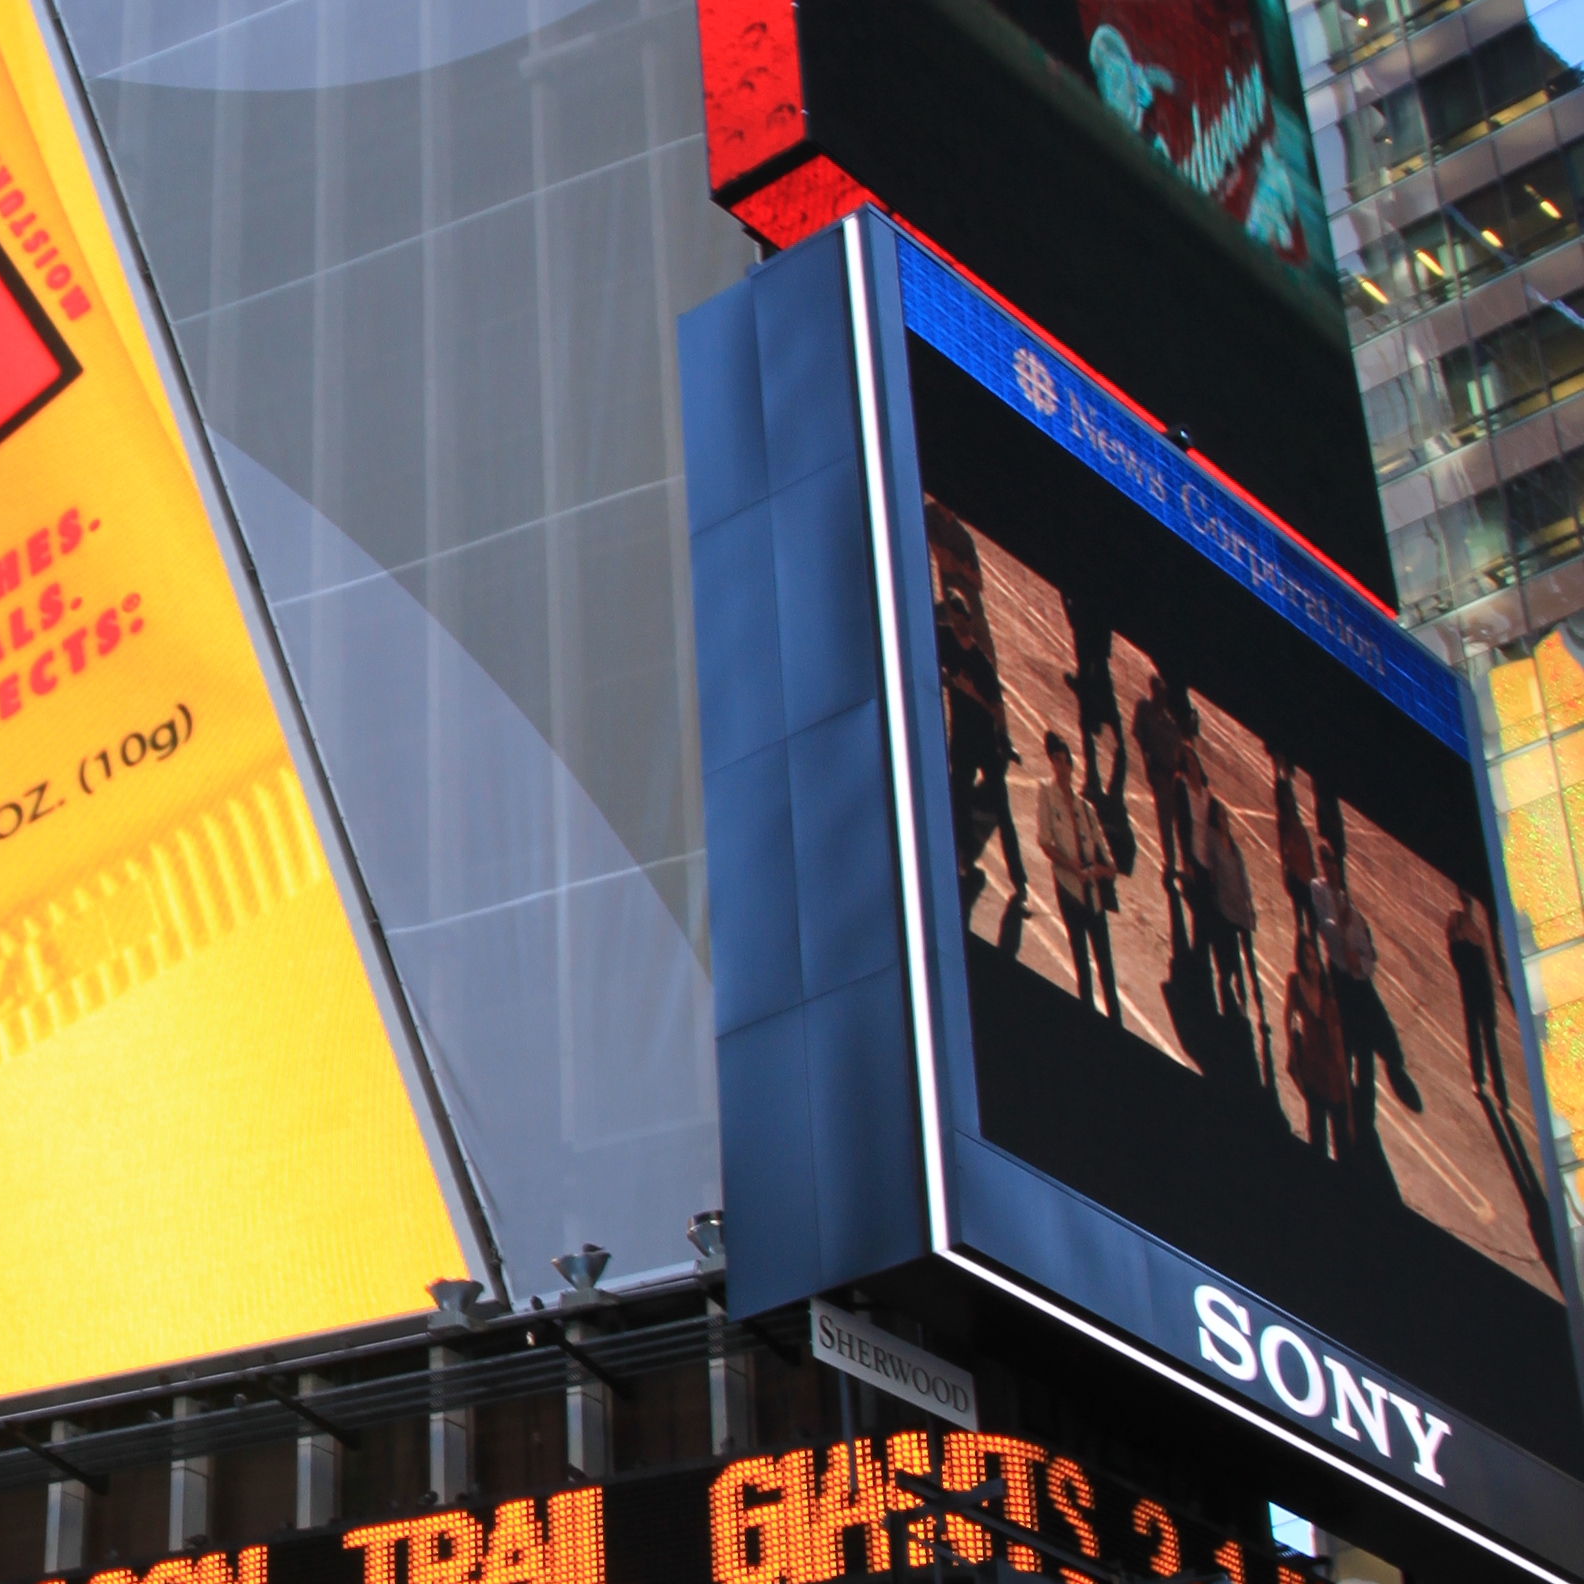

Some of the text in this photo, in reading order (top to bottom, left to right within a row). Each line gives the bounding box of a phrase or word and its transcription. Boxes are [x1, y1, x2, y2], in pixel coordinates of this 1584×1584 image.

[1068, 389, 1386, 676] News Corporation
[77, 703, 195, 795] (10g)
[818, 1312, 970, 1415] SHERWOOD
[1193, 1284, 1453, 1488] SONY
